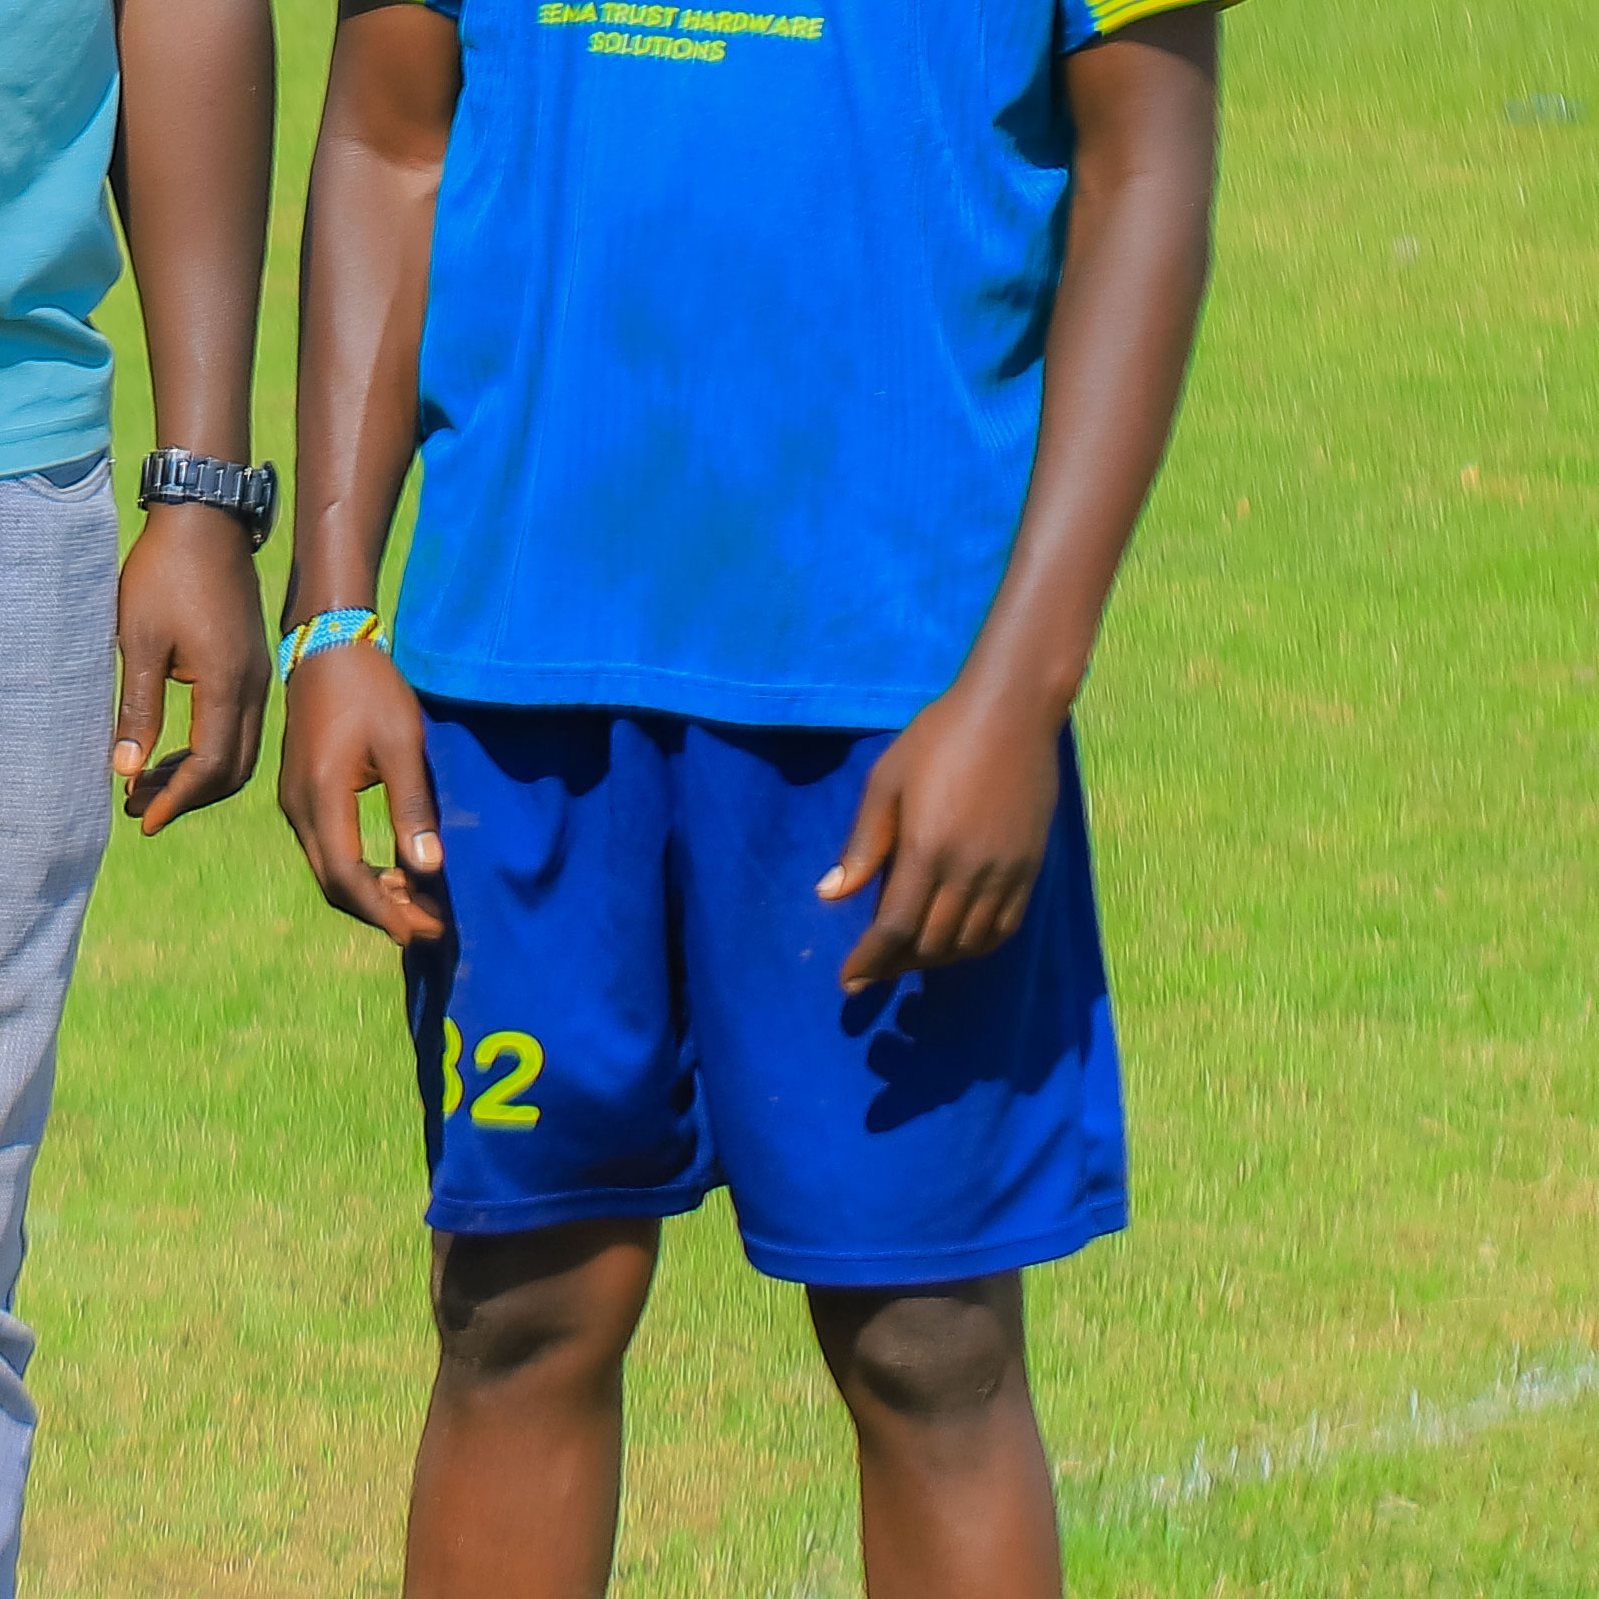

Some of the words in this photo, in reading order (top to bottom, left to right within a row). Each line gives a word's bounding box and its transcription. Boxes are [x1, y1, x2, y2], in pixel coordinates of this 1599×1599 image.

[599, 2, 680, 29] TRUST
[677, 8, 825, 40] HARDWARE
[588, 31, 727, 62] SOLUTIONS
